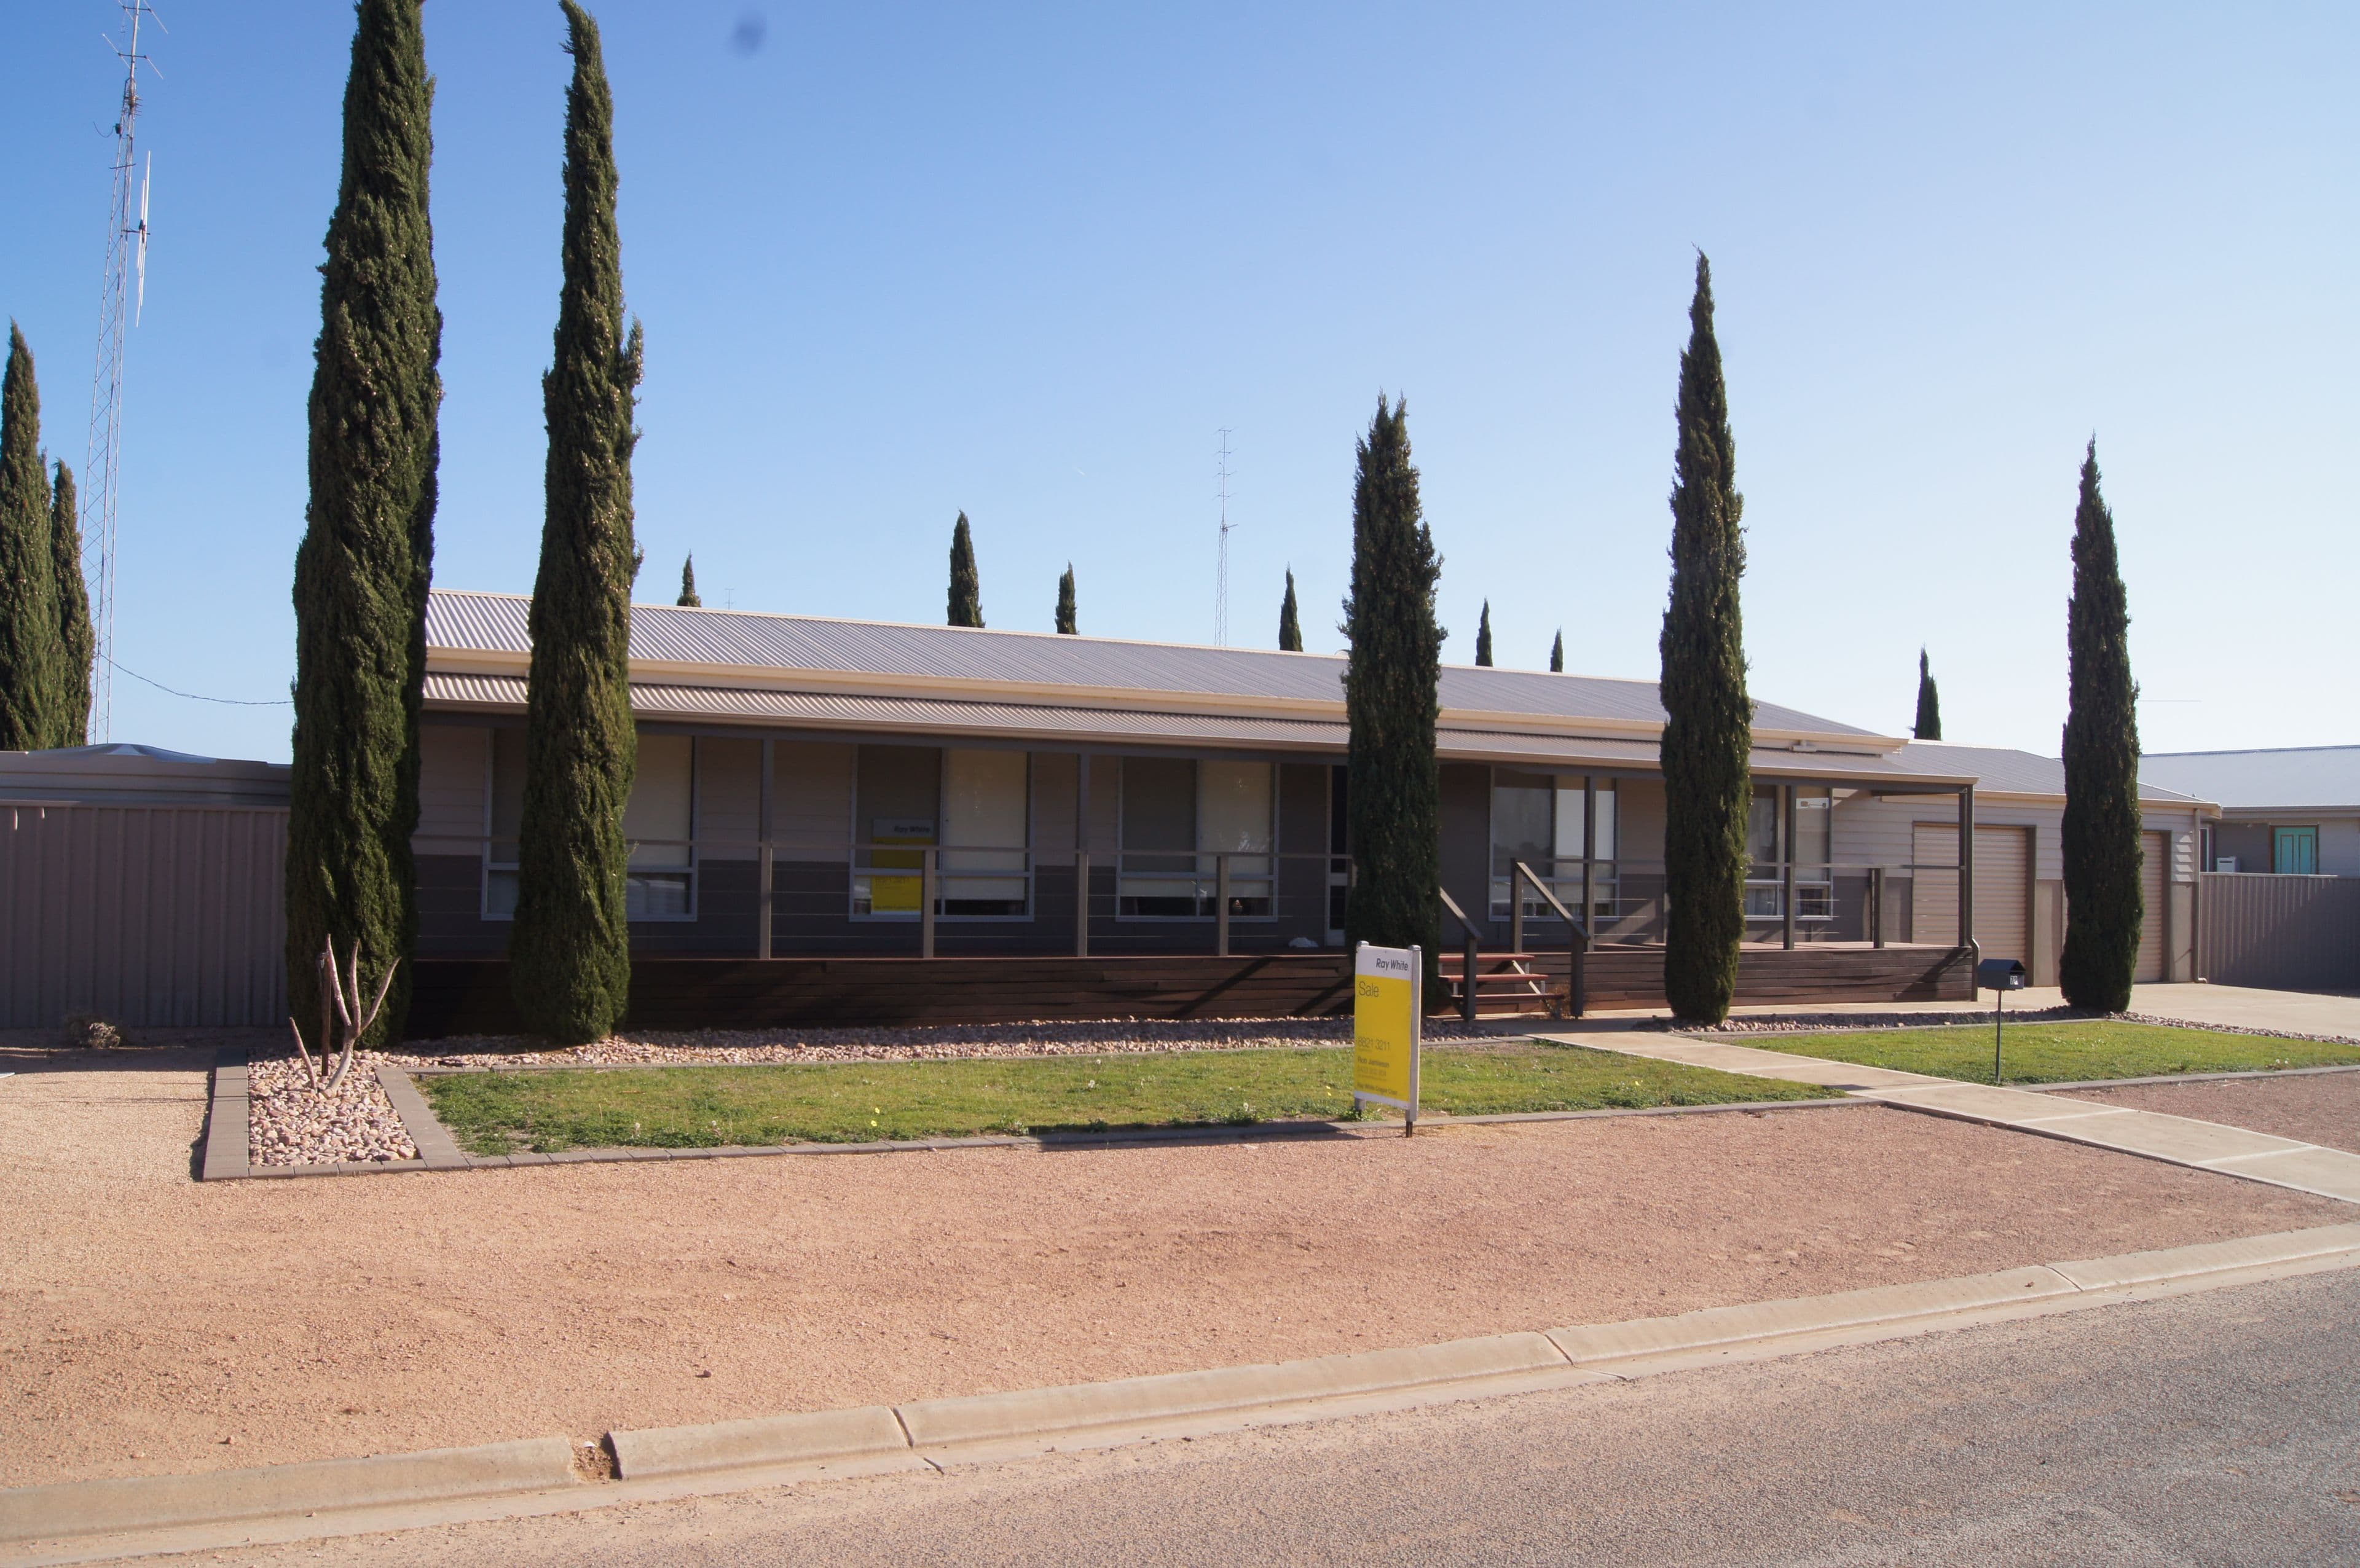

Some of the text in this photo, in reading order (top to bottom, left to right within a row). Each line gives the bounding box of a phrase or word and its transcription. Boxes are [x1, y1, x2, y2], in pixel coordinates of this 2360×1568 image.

[1376, 958, 1408, 971] Ray White
[1359, 981, 1379, 997] Sale
